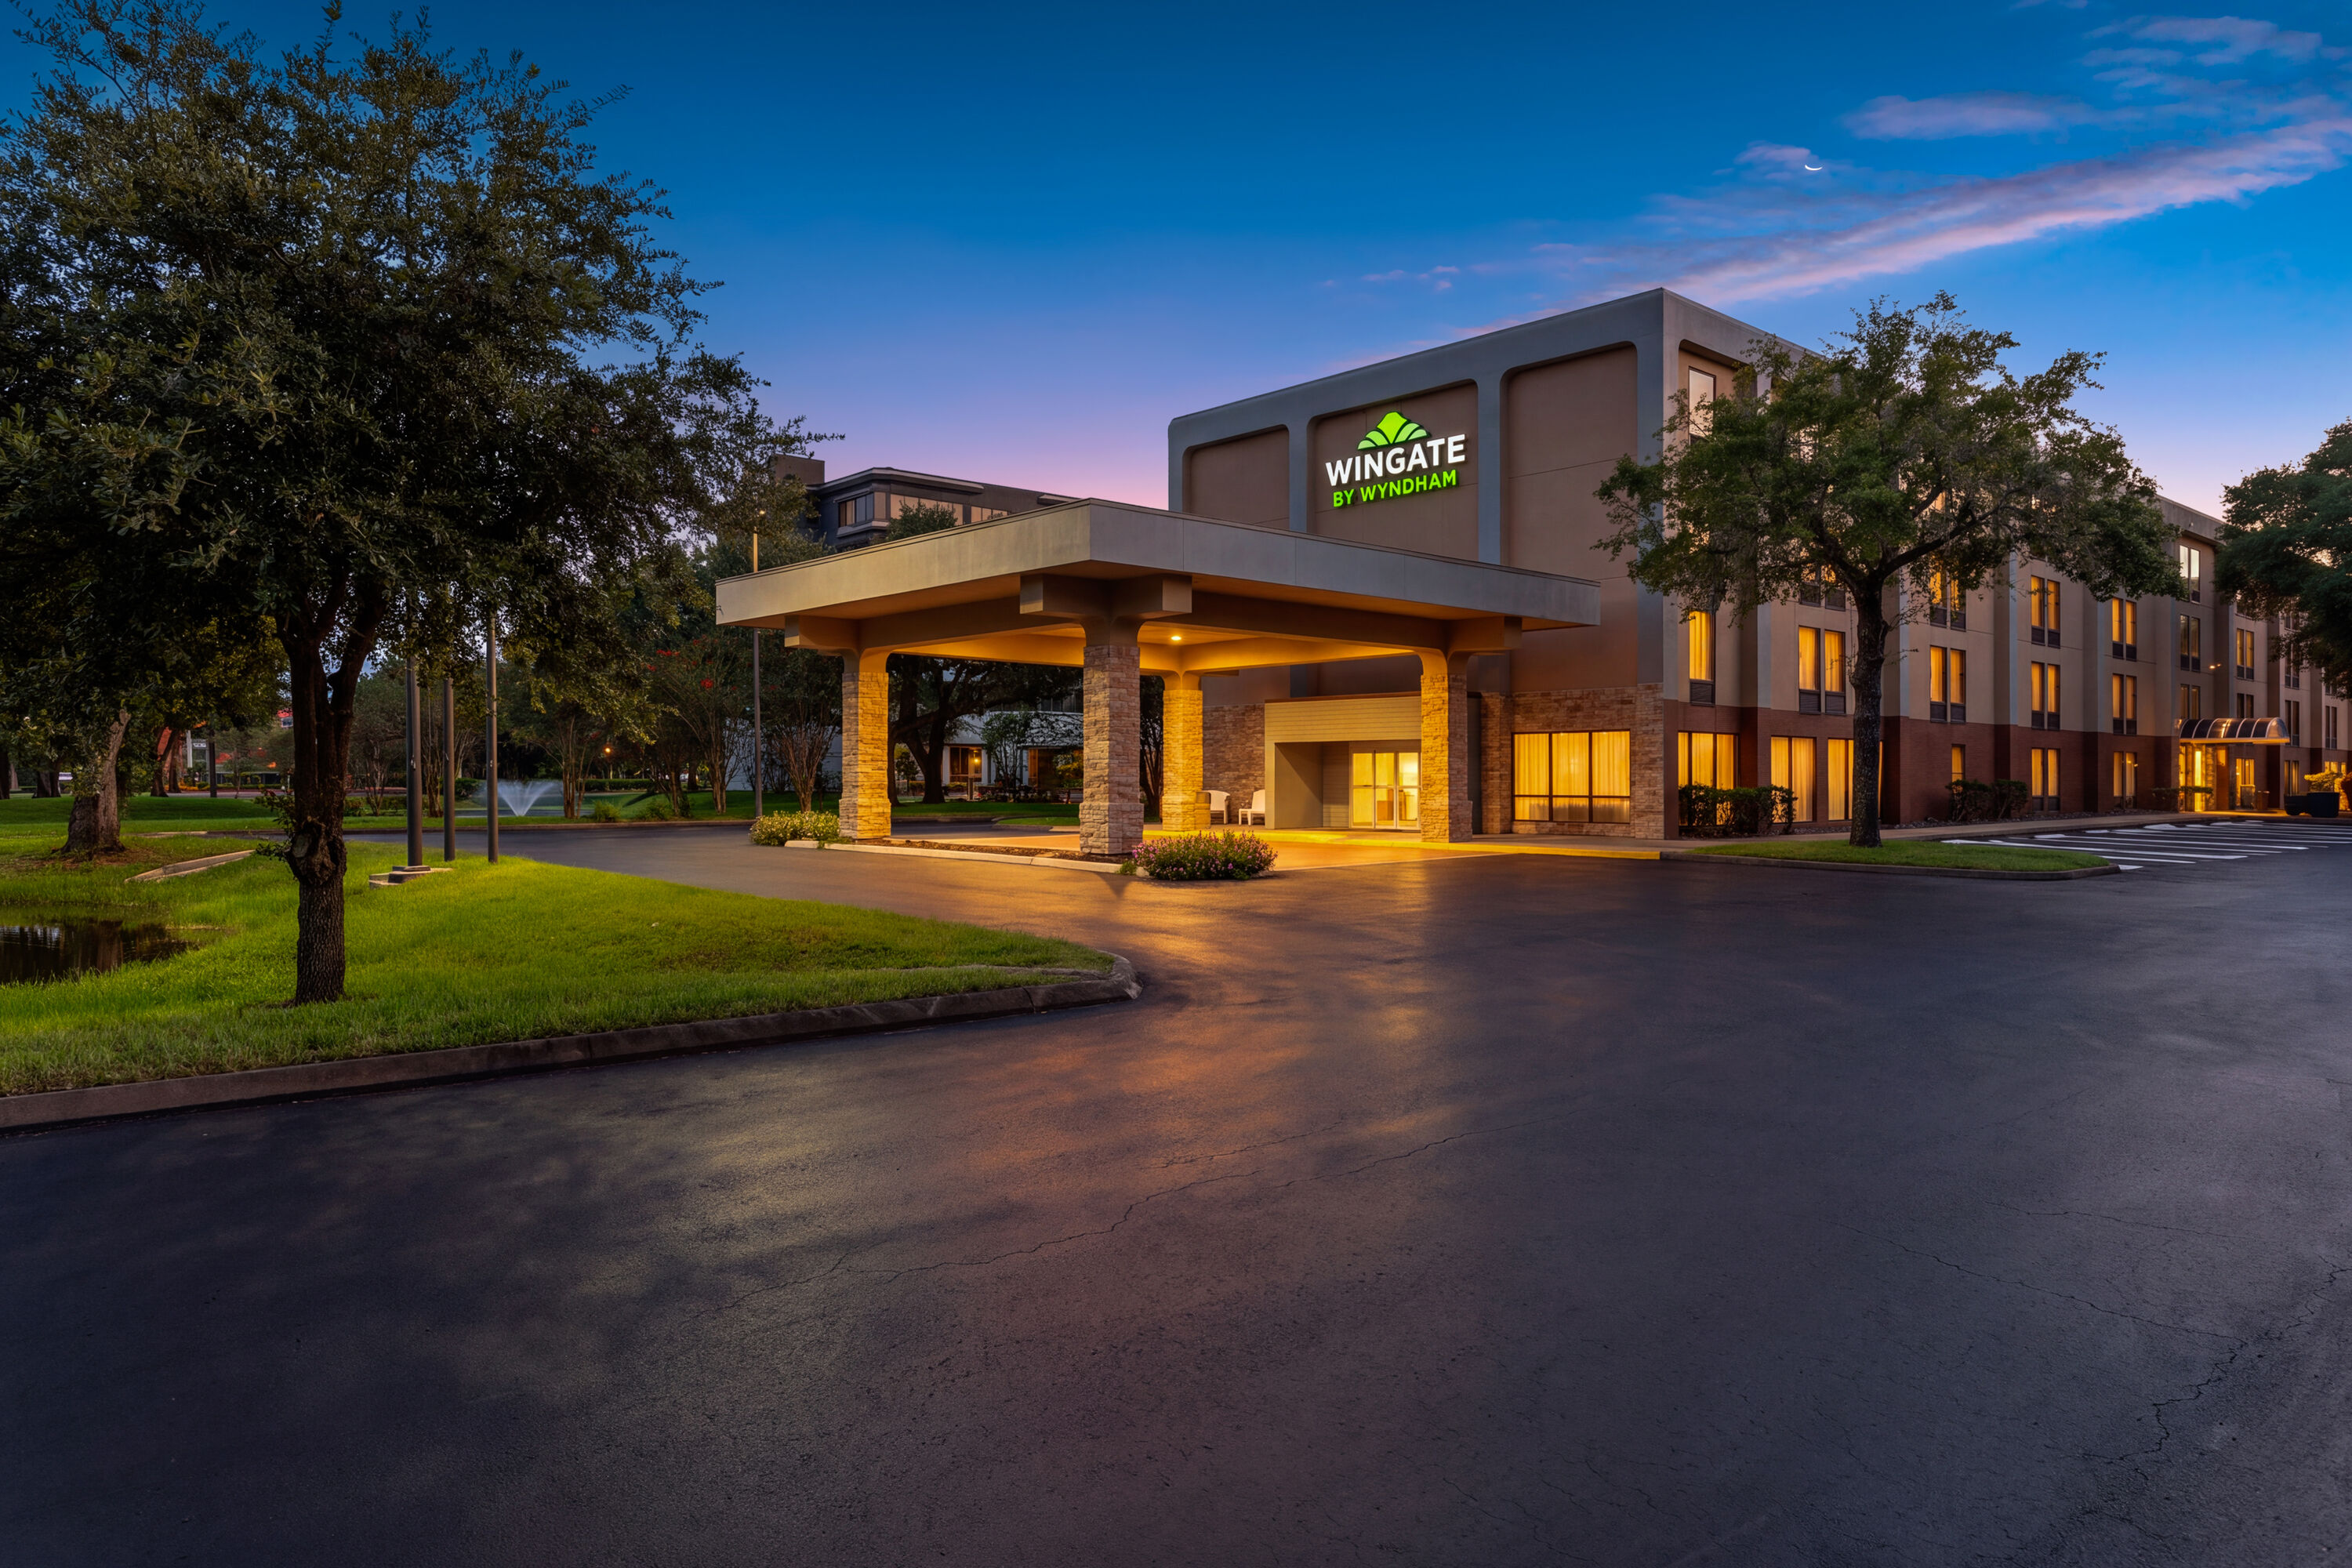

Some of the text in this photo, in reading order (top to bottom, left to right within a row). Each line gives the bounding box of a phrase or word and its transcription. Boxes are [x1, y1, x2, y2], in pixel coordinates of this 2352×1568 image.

[1325, 434, 1465, 486] WINGATE
[1333, 469, 1457, 507] BY WYNDHAM
